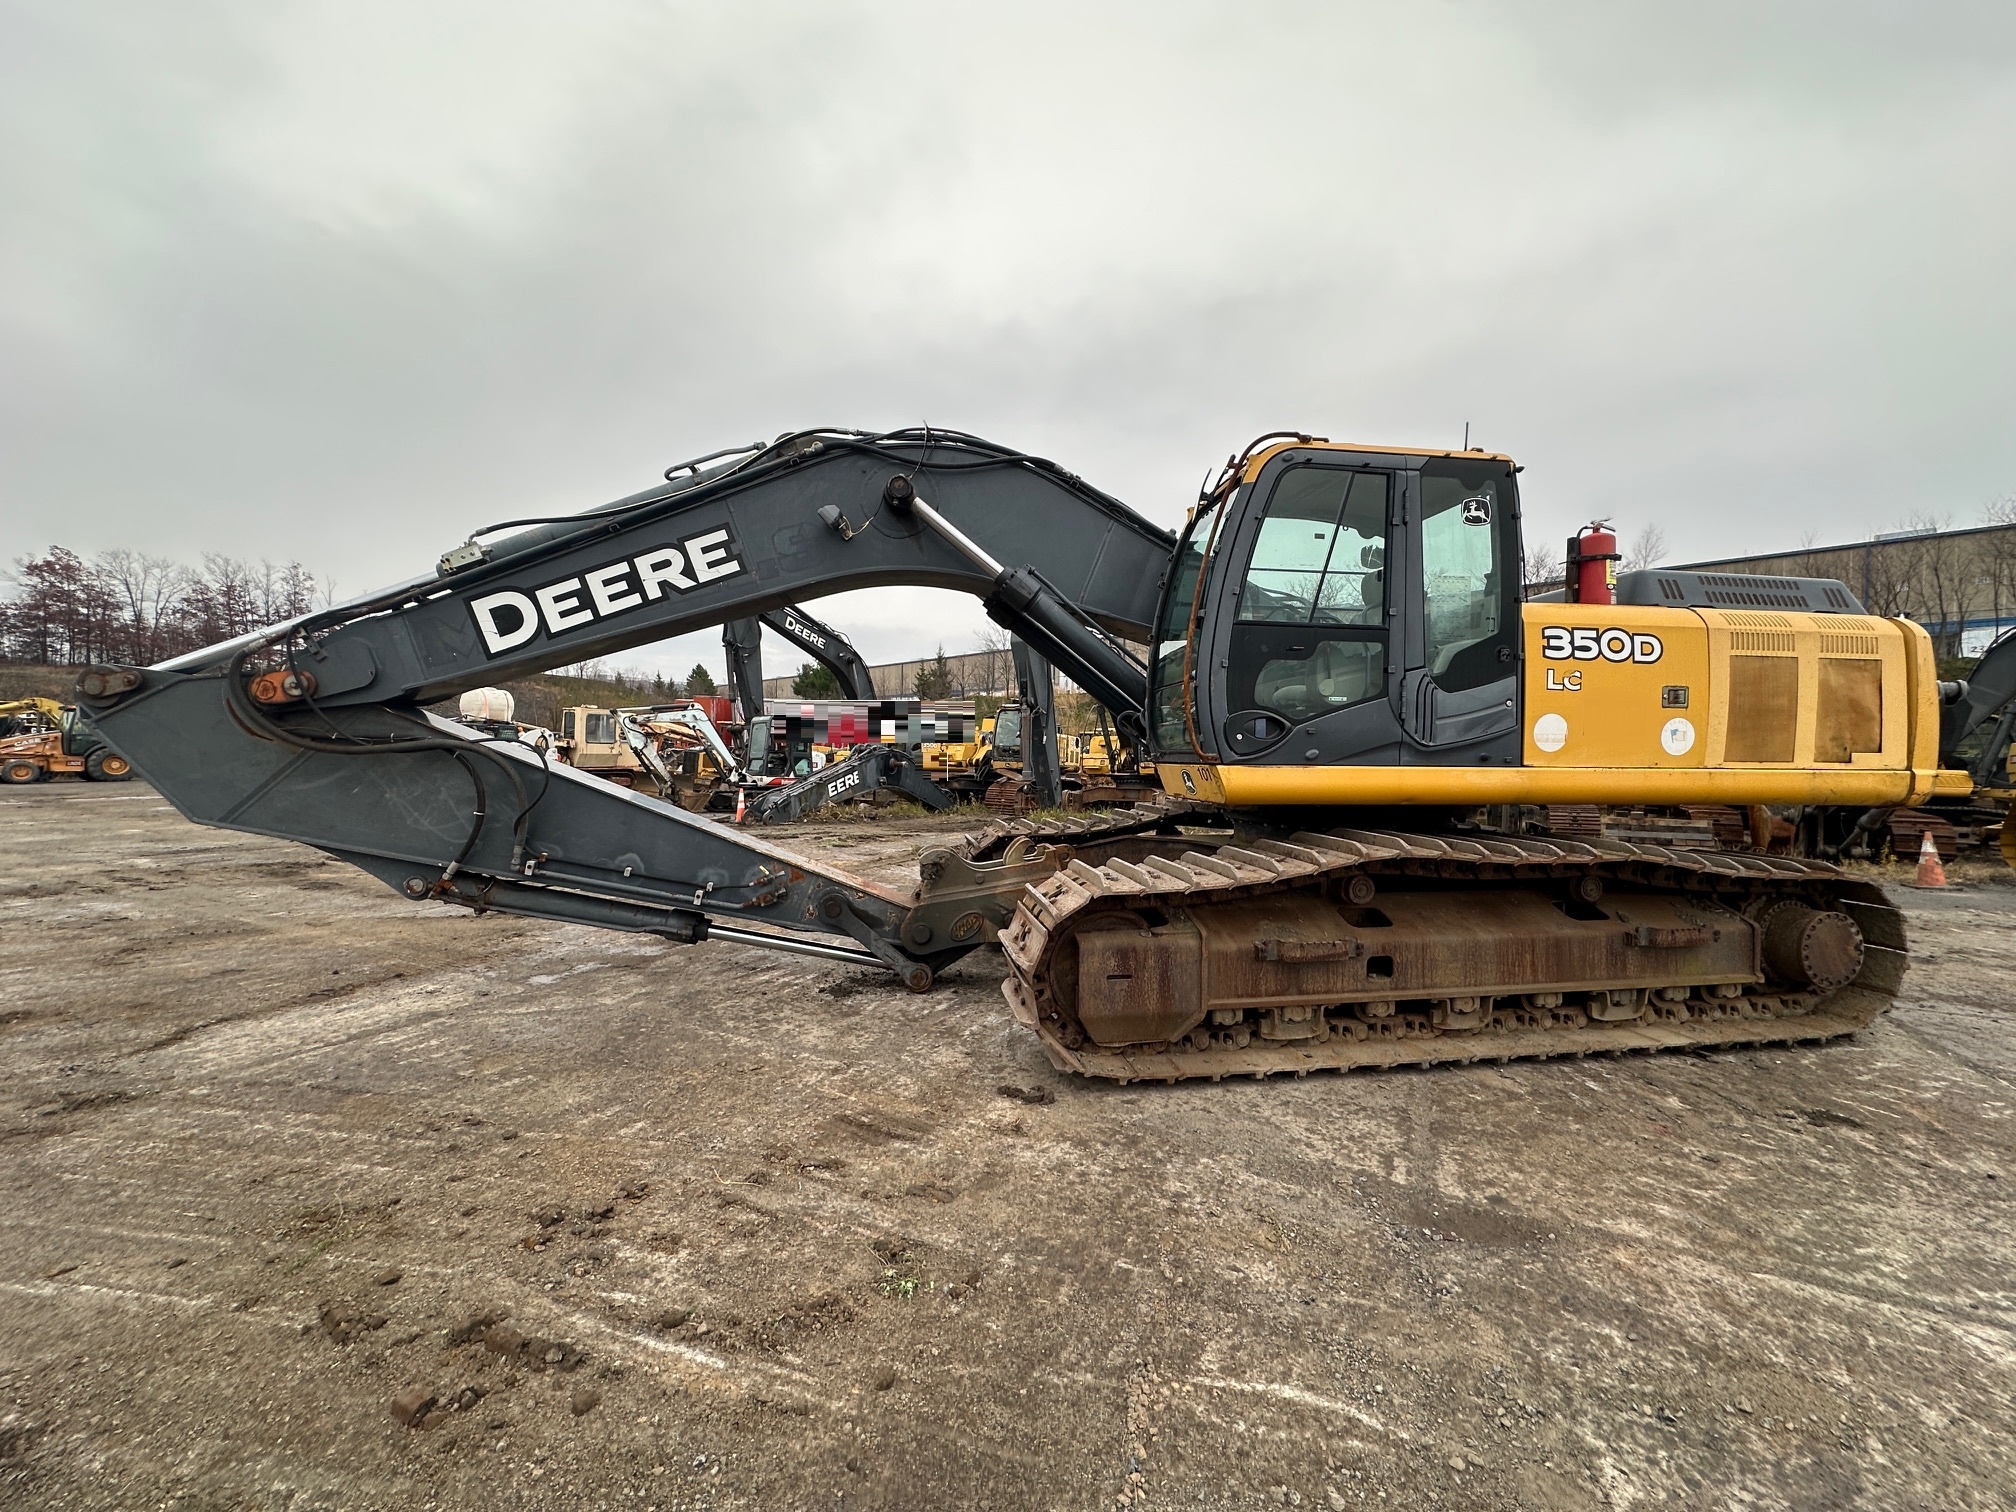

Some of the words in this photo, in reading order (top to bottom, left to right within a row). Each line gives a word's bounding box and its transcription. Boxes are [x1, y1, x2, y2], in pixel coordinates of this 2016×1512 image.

[467, 526, 743, 656] DEERE
[785, 615, 826, 649] DEERE
[1542, 625, 1663, 664] 350D
[1546, 668, 1582, 691] LC
[14, 737, 42, 747] CASE
[1197, 767, 1213, 781] 101
